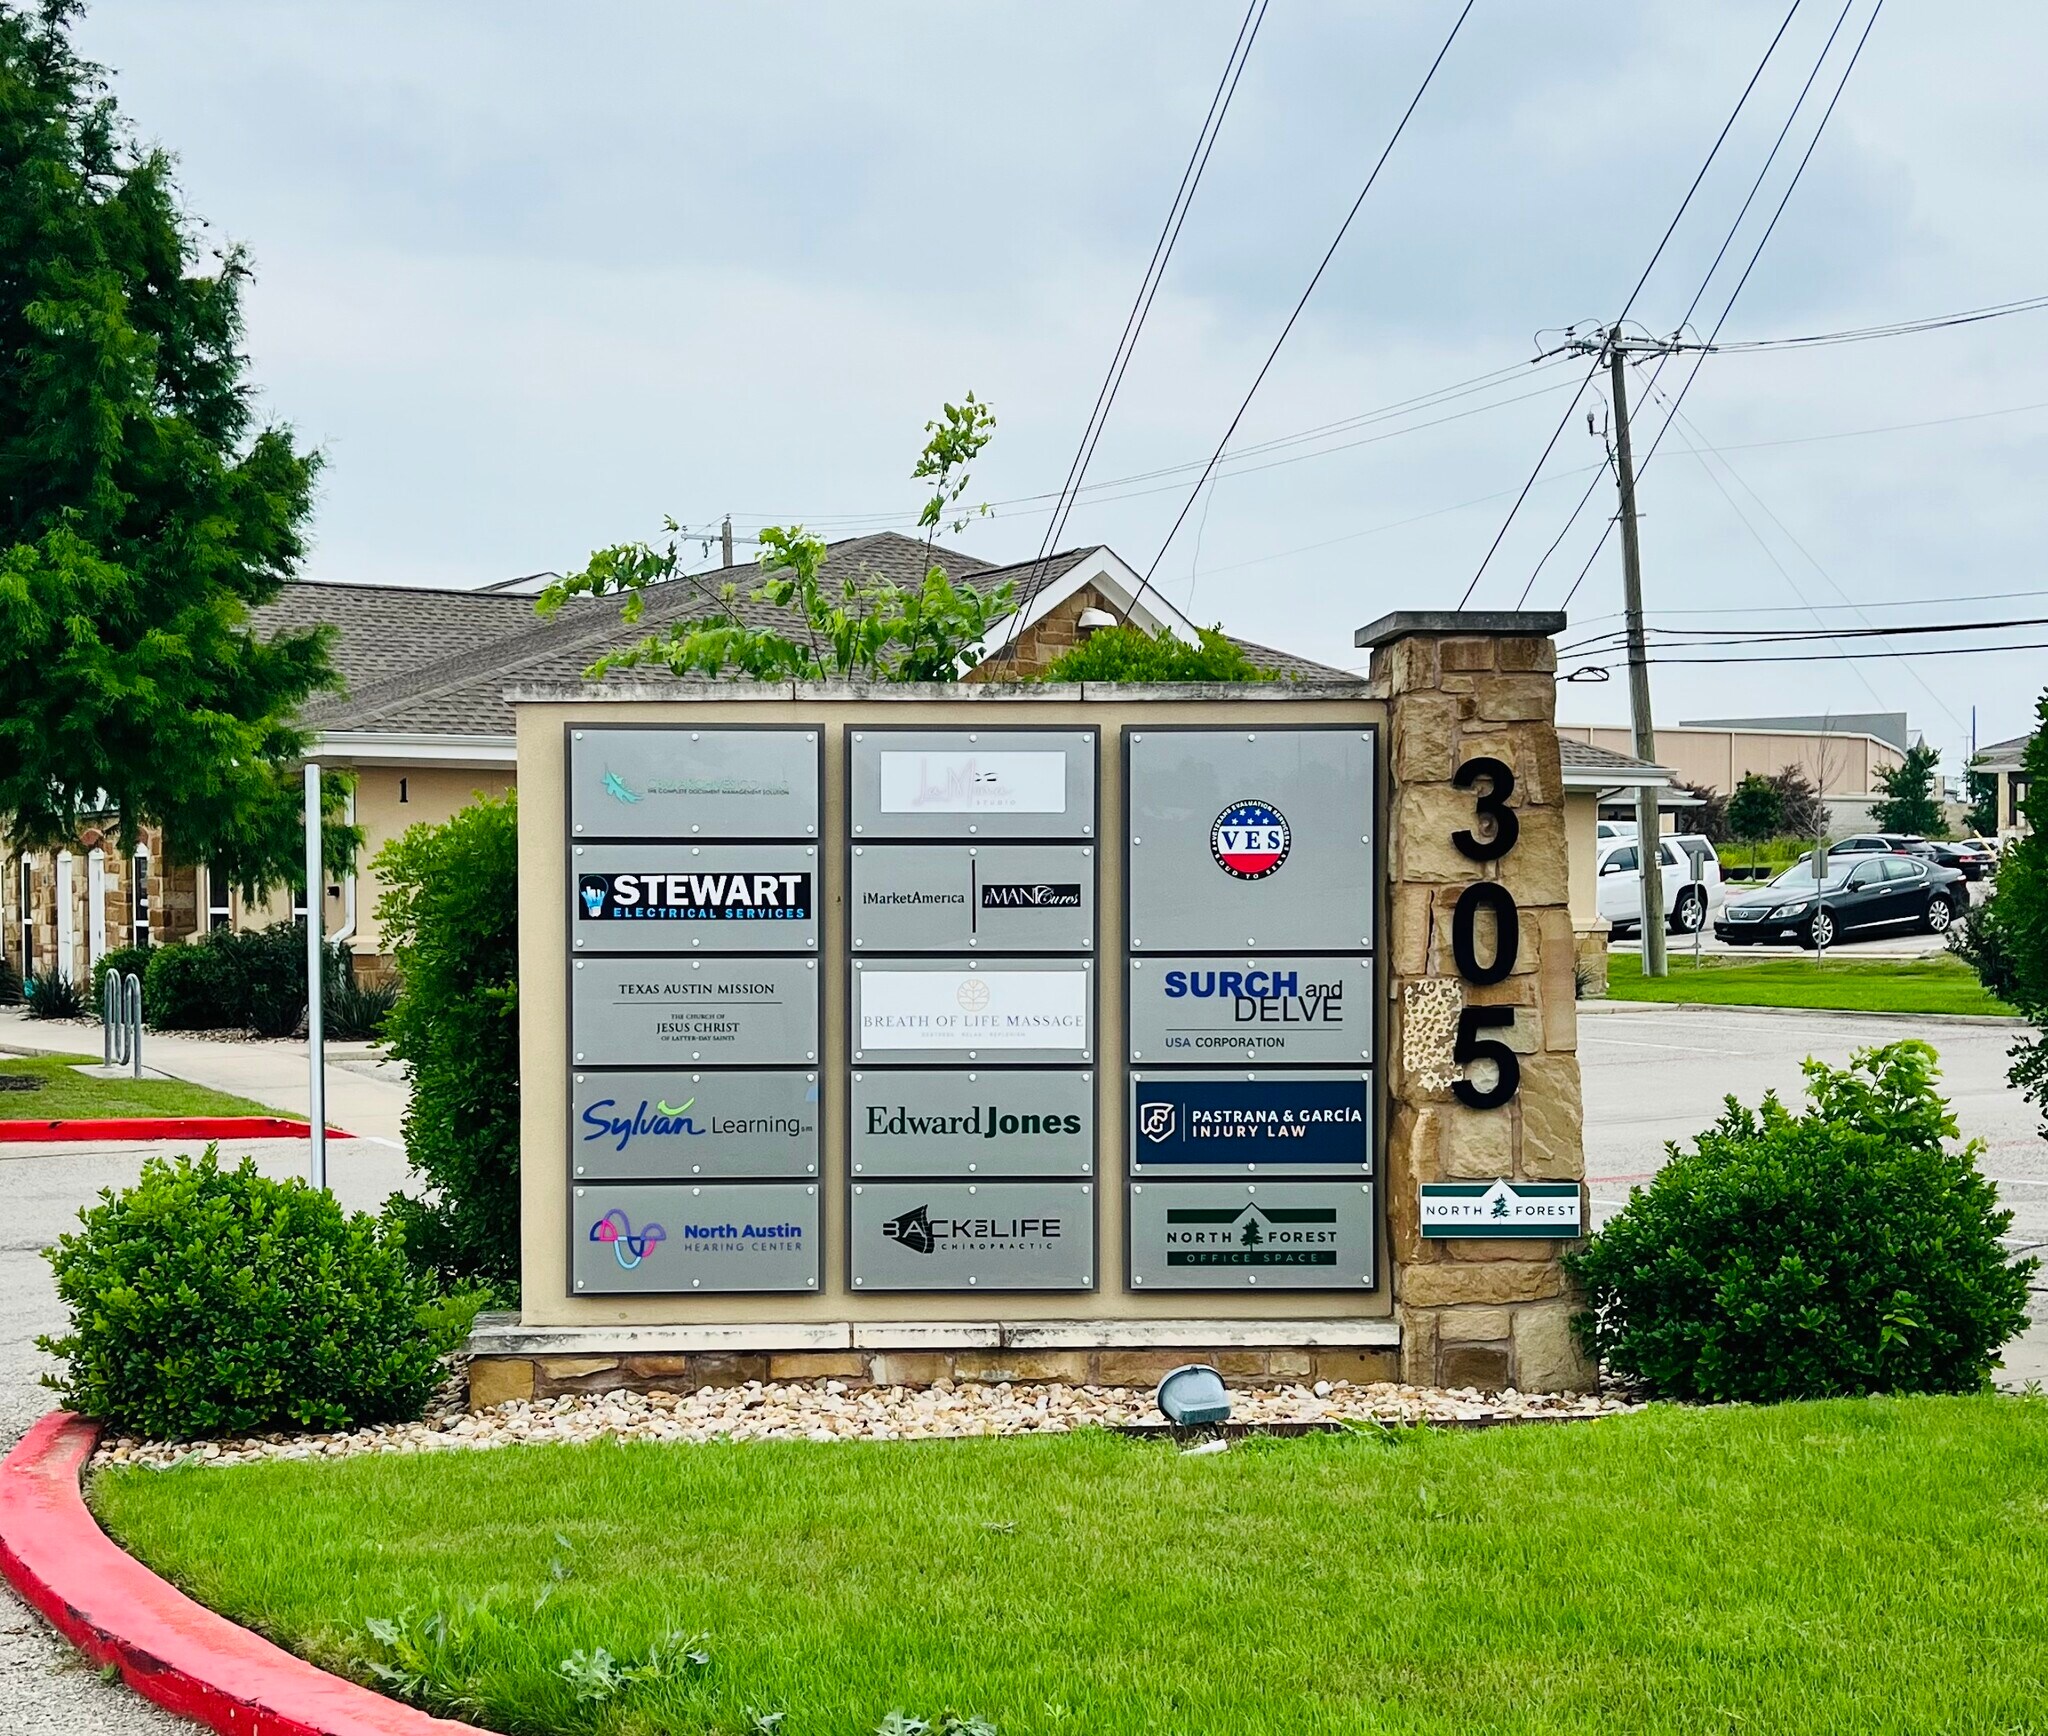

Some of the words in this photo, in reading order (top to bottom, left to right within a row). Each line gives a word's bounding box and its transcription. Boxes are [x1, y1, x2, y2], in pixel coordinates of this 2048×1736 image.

[399, 777, 409, 803] 1
[1221, 830, 1281, 850] VES
[613, 875, 802, 906] STEWART
[863, 891, 965, 904] iMarketAmerica
[613, 907, 717, 918] ELECTRICAL
[725, 908, 805, 918] SERVICES
[618, 984, 660, 994] TEXAS
[663, 984, 713, 994] AUSTIN
[717, 984, 775, 994] MISSION
[1164, 971, 1298, 998] SURCH
[1304, 980, 1342, 997] and
[1234, 996, 1343, 1022] DELVE
[863, 1015, 929, 1027] BREATH
[936, 1015, 958, 1027] OF
[964, 1015, 1000, 1027] LIFE
[1006, 1014, 1083, 1027] MASSAGE
[656, 1022, 690, 1034] JESUS
[694, 1022, 740, 1033] CHRIST
[1165, 1037, 1191, 1048] USA
[1195, 1037, 1285, 1048] CORPORATION
[1192, 1110, 1278, 1123] PASTRANA
[1283, 1110, 1293, 1122] &
[1299, 1107, 1362, 1122] GARCÍA
[582, 1099, 706, 1151] Sylvan
[712, 1116, 800, 1137] Learning
[1192, 1125, 1258, 1138] INJURY
[1267, 1125, 1306, 1137] LAW
[1426, 1205, 1483, 1216] NORTH
[1515, 1205, 1576, 1216] FOREST
[684, 1224, 738, 1239] North
[742, 1223, 802, 1238] Austin
[1166, 1231, 1232, 1243] NORTH
[1268, 1231, 1337, 1242] FOREST
[684, 1242, 744, 1252] HEARING
[751, 1242, 802, 1251] CENTER
[1187, 1254, 1251, 1263] OFFICE
[1263, 1254, 1318, 1263] SPACE
